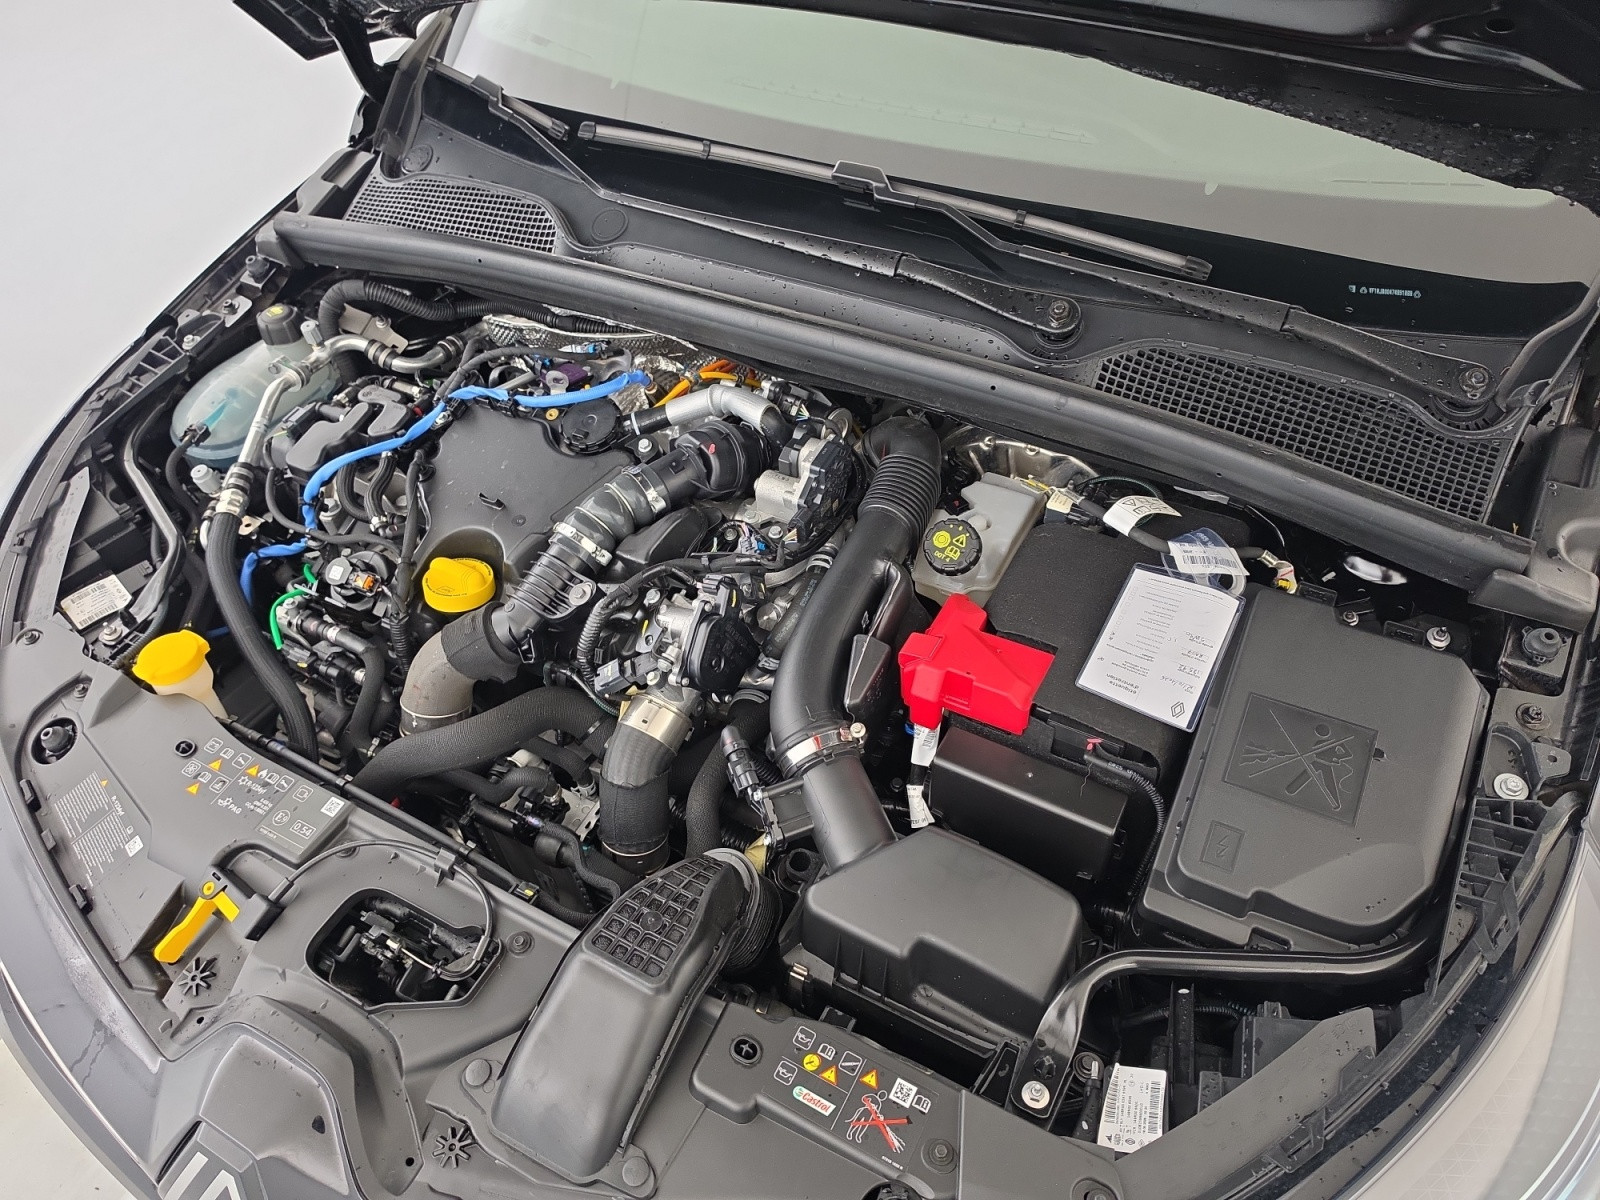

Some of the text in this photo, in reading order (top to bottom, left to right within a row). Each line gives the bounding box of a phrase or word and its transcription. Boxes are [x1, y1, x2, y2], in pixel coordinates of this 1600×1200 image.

[934, 550, 946, 560] DOT
[246, 780, 267, 794] R-1234yf
[228, 804, 242, 814] PAG
[294, 823, 312, 836] 0,54
[802, 1091, 831, 1113] Castrol
